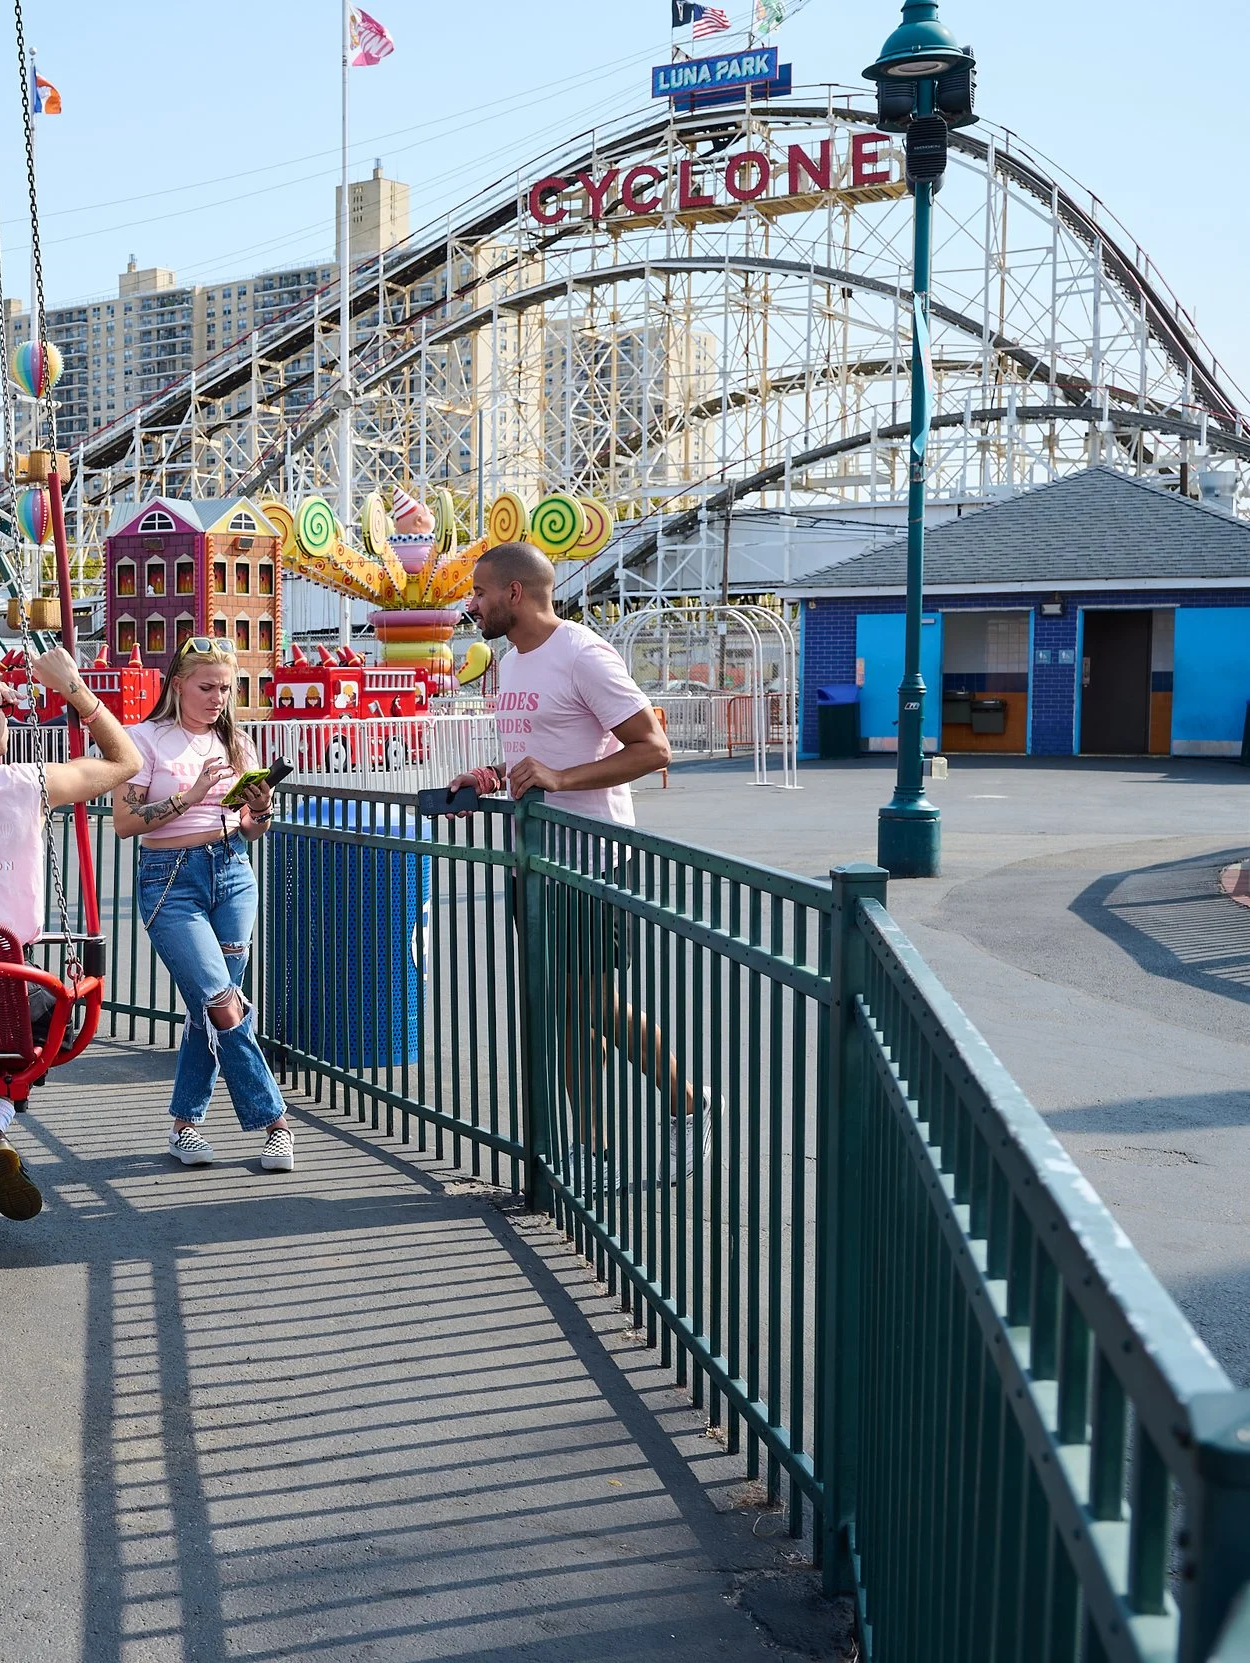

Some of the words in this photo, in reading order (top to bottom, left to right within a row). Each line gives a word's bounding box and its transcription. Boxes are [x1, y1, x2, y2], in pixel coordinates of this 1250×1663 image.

[658, 63, 712, 91] LUNA
[715, 53, 770, 82] PARK
[529, 132, 891, 225] CYCLONE
